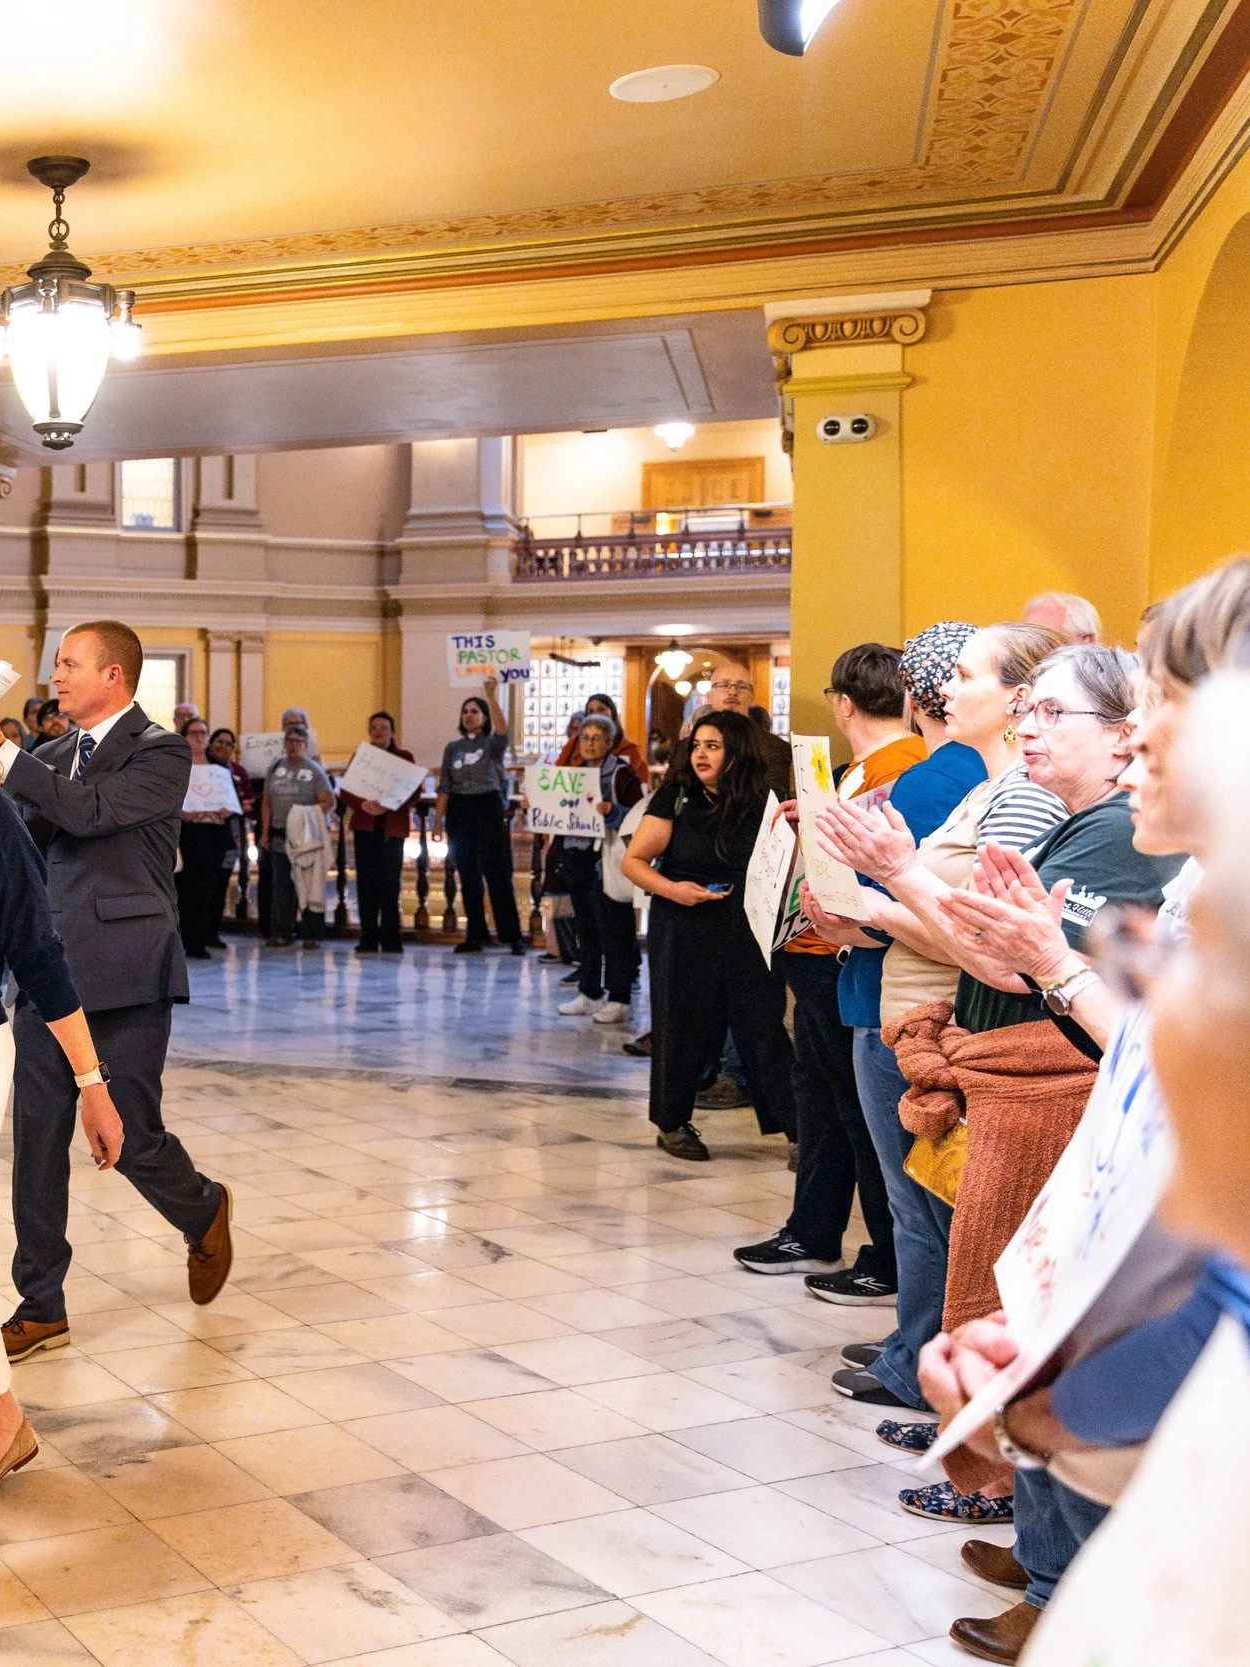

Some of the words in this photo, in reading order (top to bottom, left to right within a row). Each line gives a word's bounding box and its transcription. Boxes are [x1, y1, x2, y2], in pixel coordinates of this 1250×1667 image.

[452, 635, 495, 648] THIS
[458, 648, 521, 664] PASTOR
[538, 768, 586, 794] SAVE
[532, 807, 563, 829] Public
[567, 812, 601, 832] Schools
